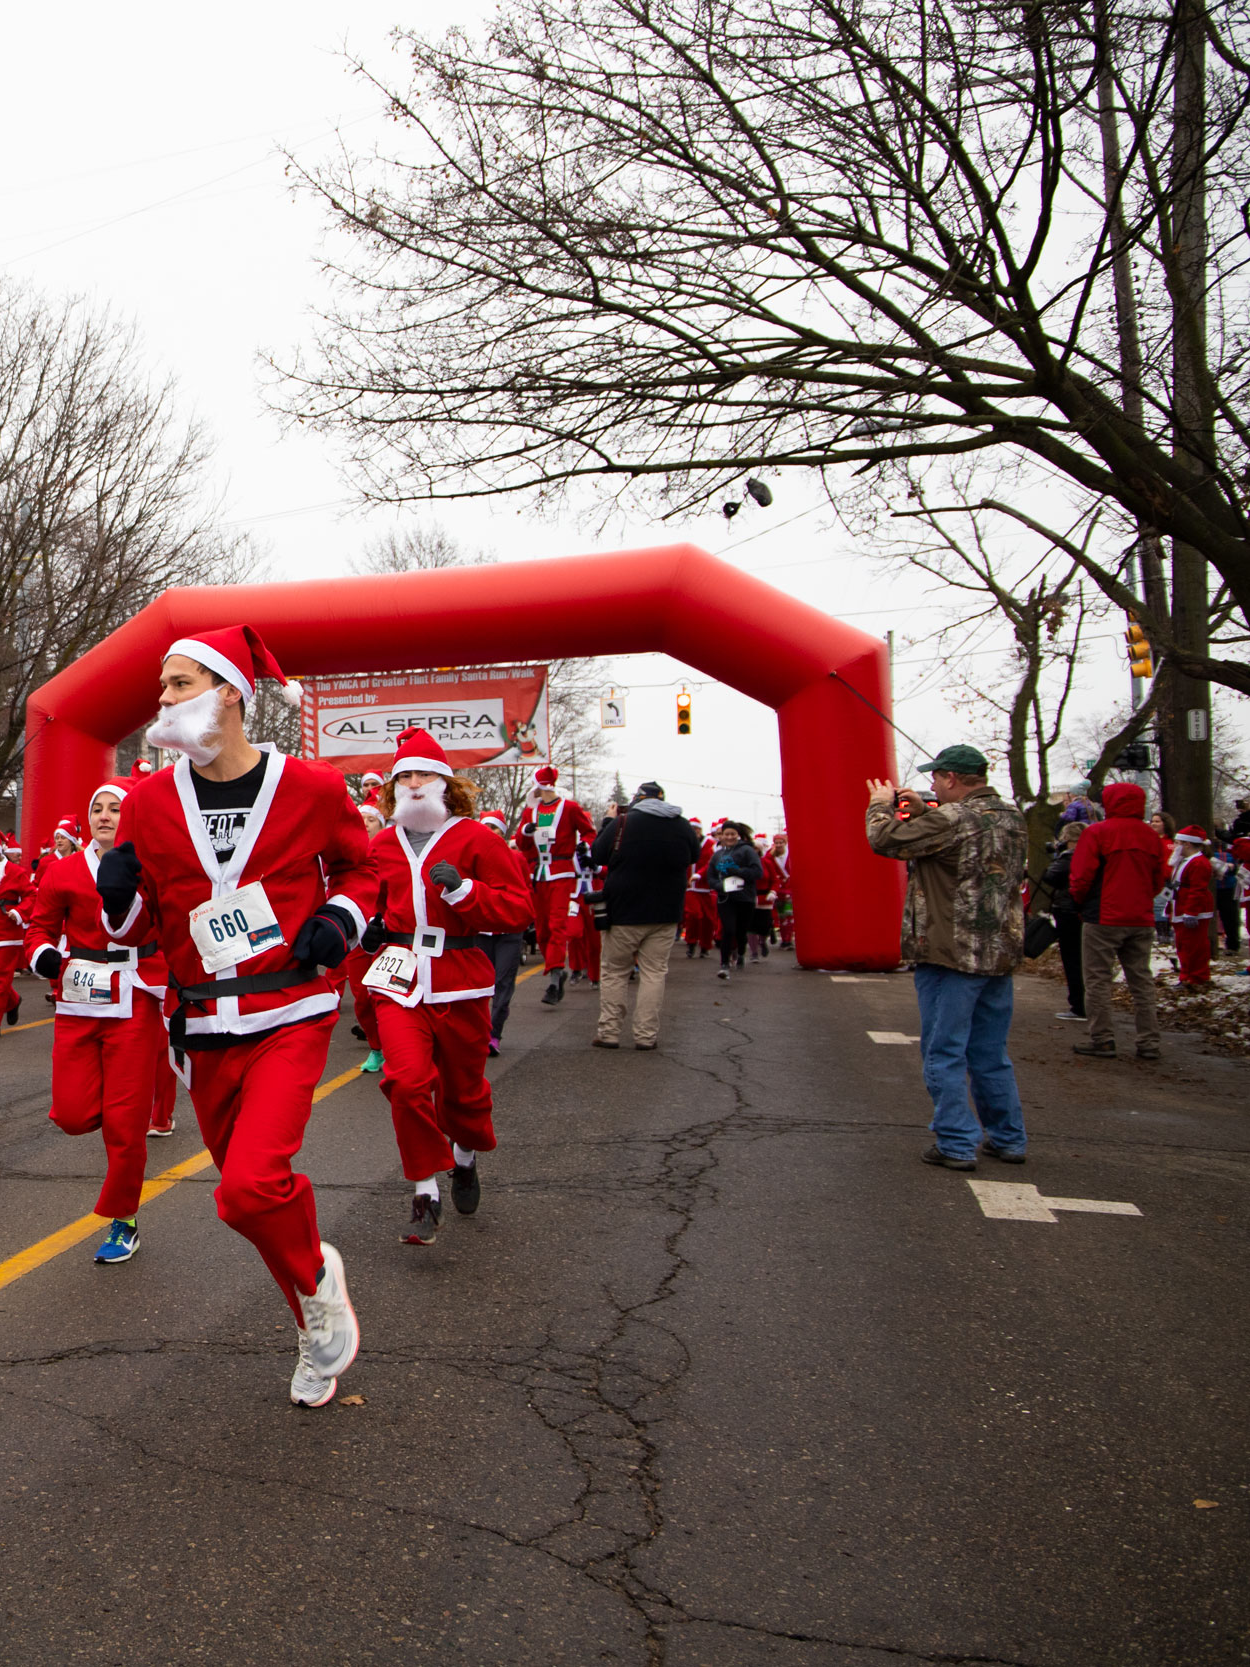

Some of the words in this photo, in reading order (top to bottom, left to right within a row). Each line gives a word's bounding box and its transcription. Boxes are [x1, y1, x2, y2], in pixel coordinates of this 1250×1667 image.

[316, 681, 331, 692] The
[334, 679, 359, 690] YMCA
[361, 679, 370, 689] of
[372, 675, 407, 688] Greater
[409, 674, 429, 685] Flint
[431, 672, 459, 684] Family
[462, 670, 488, 682] Santa
[490, 668, 535, 680] Run/Walk
[318, 694, 363, 706] Presented
[365, 693, 379, 704] by:
[337, 720, 378, 735] AL
[386, 714, 497, 732] SERRA
[438, 731, 495, 741] PLAZA
[209, 908, 249, 942] 660
[375, 956, 404, 974] 2327
